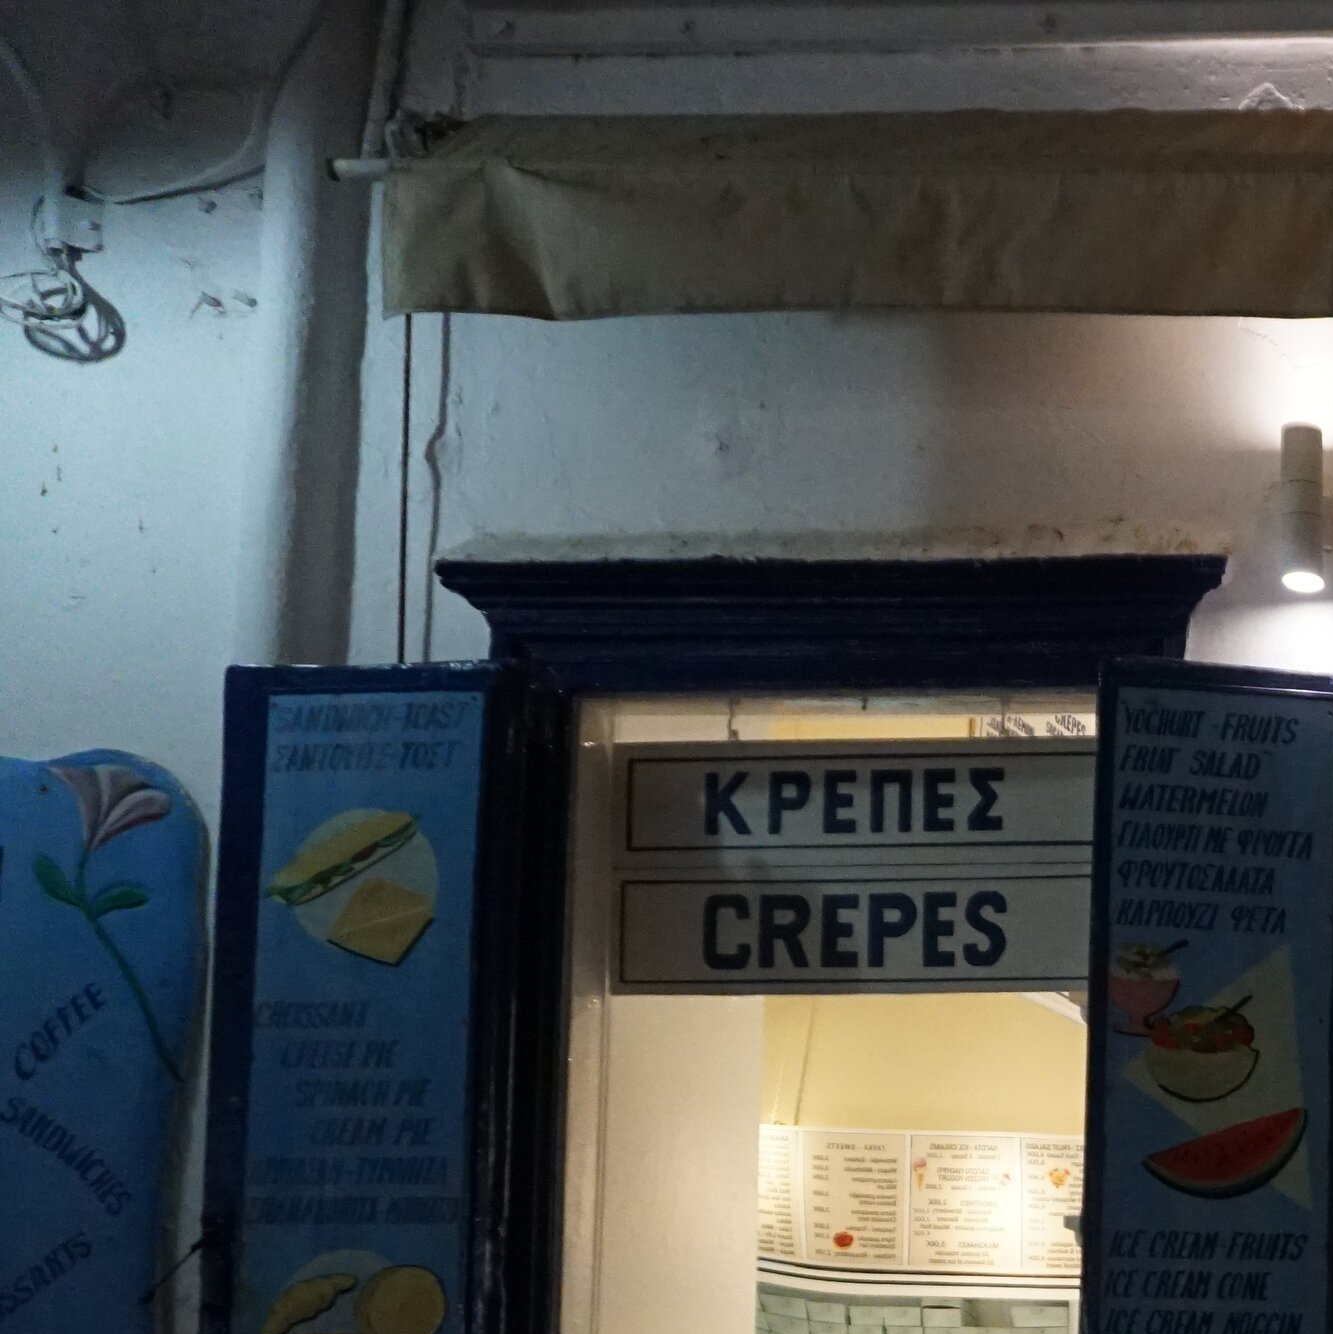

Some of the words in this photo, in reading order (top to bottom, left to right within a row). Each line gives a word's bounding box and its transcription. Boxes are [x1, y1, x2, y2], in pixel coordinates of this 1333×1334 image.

[1120, 744, 1180, 773] FRUIT
[1189, 751, 1261, 780] SALAD
[703, 767, 1006, 836] ΚΡΕΠΕΣ
[1118, 784, 1268, 818] WATERMELON
[1117, 821, 1201, 853] ΓΙΑΟΥΡΤΙ
[1204, 827, 1233, 853] ΜΕ
[1237, 830, 1314, 861] ΦΡΟΥΤΑ
[702, 890, 1008, 971] CREPES
[1116, 898, 1218, 931] ΚΑΡΠΟΥΖΙ
[1230, 906, 1287, 934] ΦΕΤΑ
[14, 982, 106, 1080] COFFEE
[280, 1040, 357, 1069] CHEESE
[361, 1039, 399, 1068] PIE
[296, 1079, 390, 1107] SPINACH
[394, 1078, 431, 1106] PIE
[310, 1117, 388, 1145] CREAM
[394, 1117, 436, 1145] PIE
[0, 1097, 132, 1215] SANDWICHES
[1109, 1229, 1147, 1259] ICE
[1149, 1231, 1219, 1260] CREAM
[1104, 1268, 1139, 1298] ICE
[1142, 1270, 1212, 1300] CREAM
[1217, 1271, 1272, 1301] CONE
